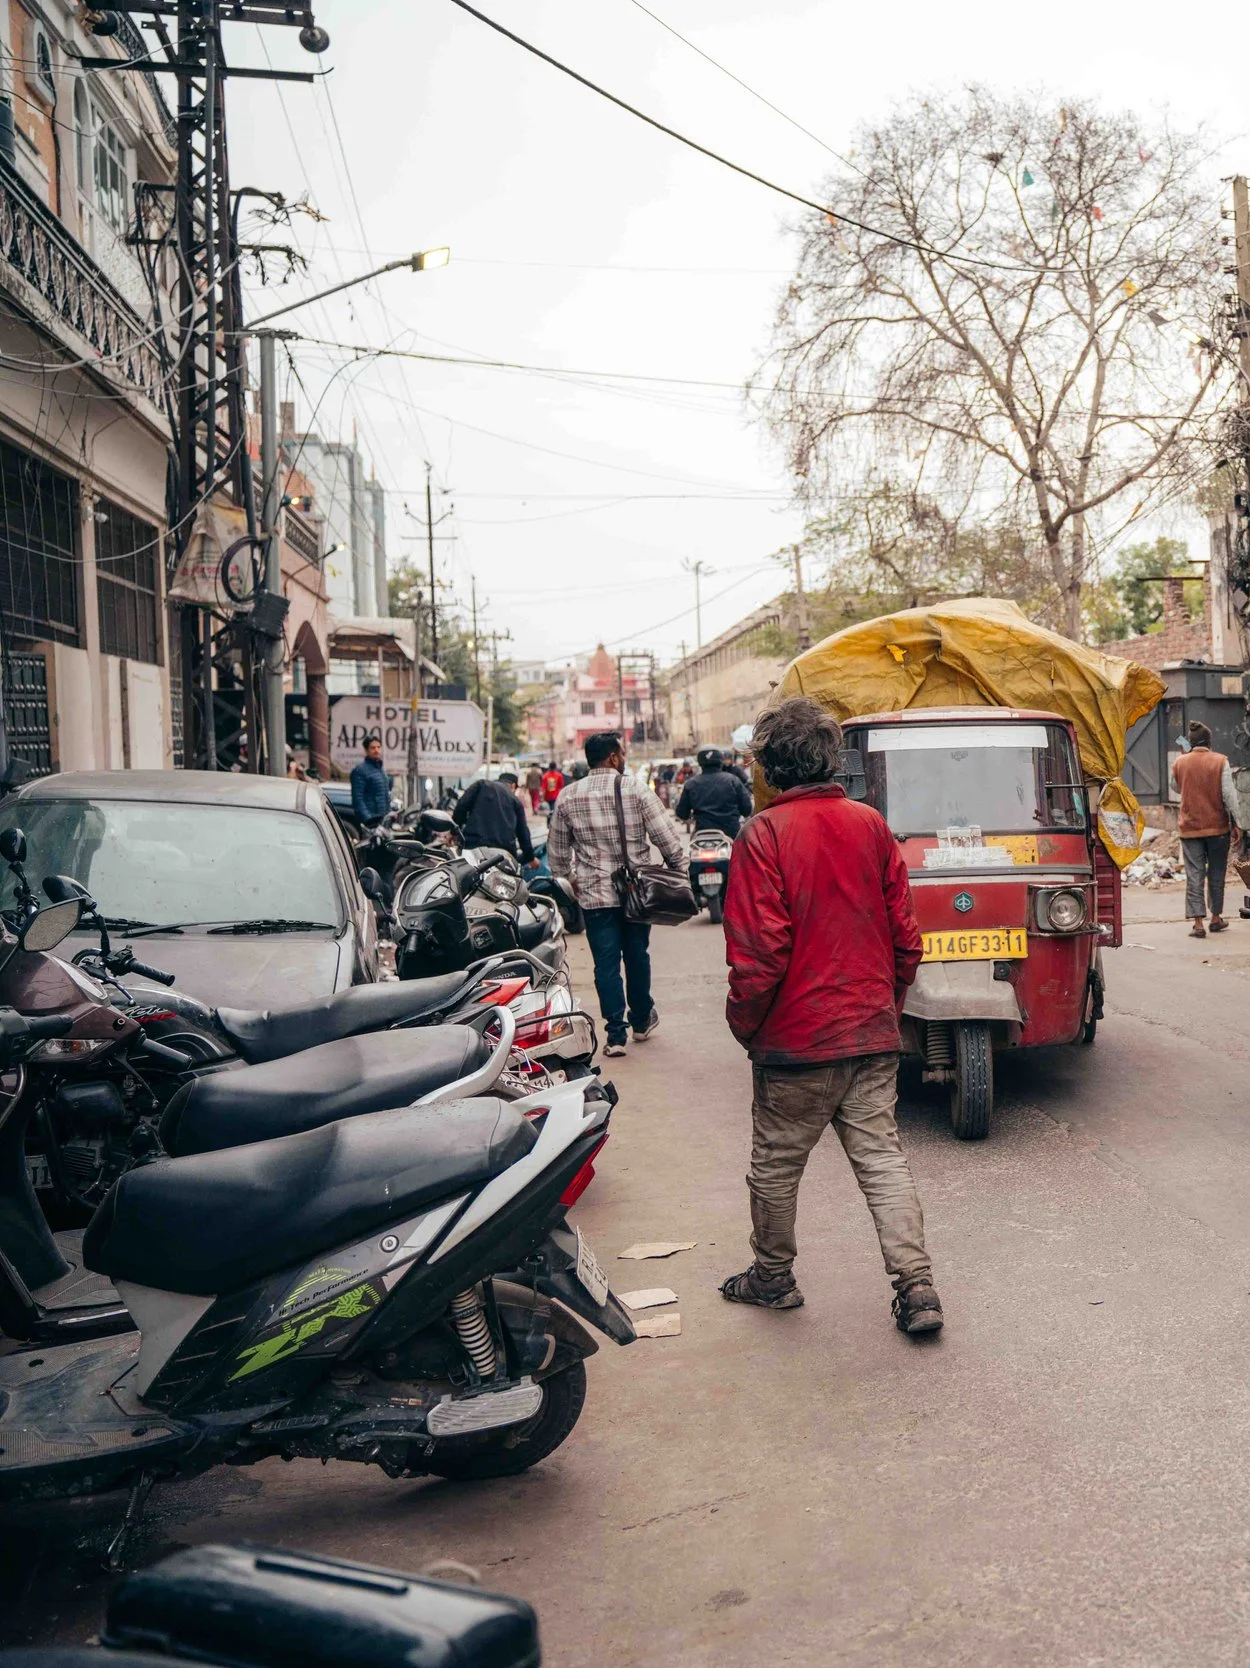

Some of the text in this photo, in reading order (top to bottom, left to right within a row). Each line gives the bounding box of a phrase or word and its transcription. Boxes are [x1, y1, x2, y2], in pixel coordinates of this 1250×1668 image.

[366, 706, 446, 723] HOTEL
[445, 741, 477, 753] DLX
[924, 934, 1023, 955] J14GF3311
